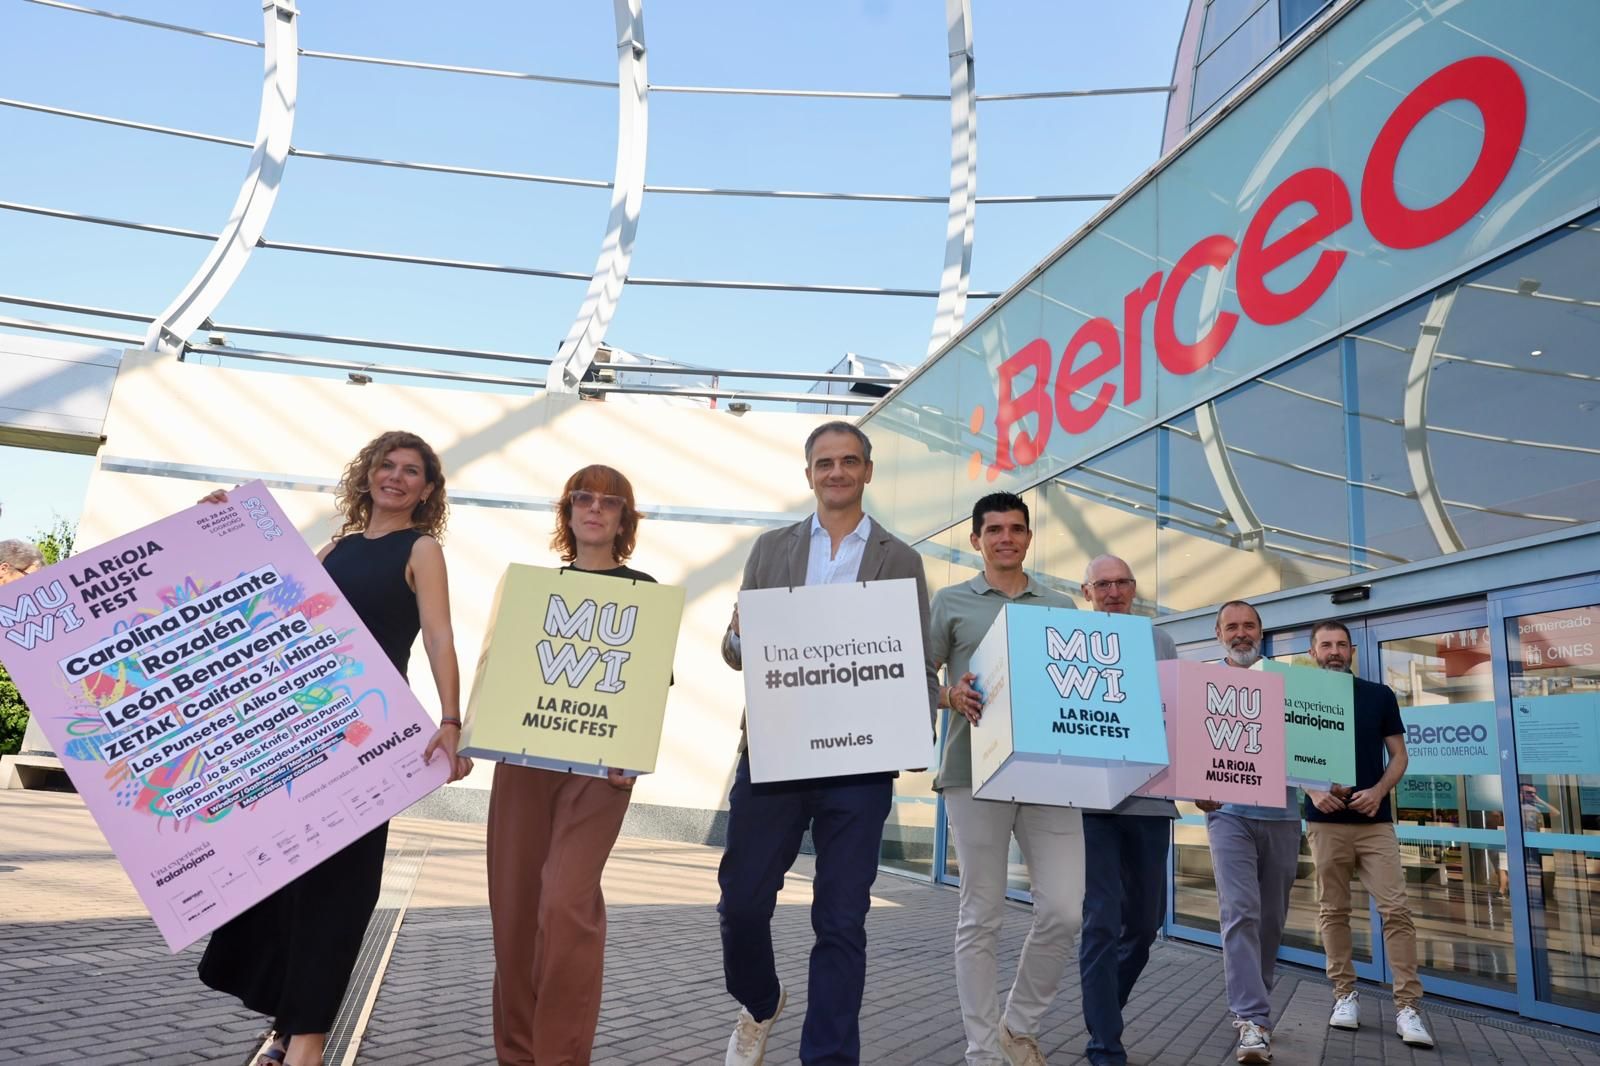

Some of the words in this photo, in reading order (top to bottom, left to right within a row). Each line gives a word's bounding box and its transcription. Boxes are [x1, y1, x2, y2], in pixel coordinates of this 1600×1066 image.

[986, 56, 1527, 482] Berceo
[196, 517, 210, 525] DEL
[212, 512, 238, 526] AGOSTO
[69, 566, 102, 588] LA
[89, 587, 139, 620] FEST
[66, 615, 181, 677] Carolina
[179, 570, 278, 624] Durante
[543, 593, 639, 646] MU
[141, 615, 247, 674] Rozalén
[763, 644, 799, 663] Una
[802, 636, 902, 662] experiencia
[1045, 626, 1121, 666] MU
[1547, 643, 1594, 660] CINES
[105, 682, 178, 729] León
[172, 617, 308, 692] Benavente
[536, 639, 632, 694] WI
[765, 660, 905, 689] #alariojana
[104, 714, 177, 760] ZETAK
[182, 670, 263, 719] Califato
[283, 633, 338, 667] Hinds
[1045, 662, 1128, 704] WI
[130, 750, 162, 774] Los
[162, 711, 236, 758] Punsetes
[242, 686, 279, 716] Aiko
[276, 680, 293, 696] el
[293, 659, 338, 690] grupo
[536, 696, 558, 712] LA
[1059, 707, 1076, 720] LA
[1206, 682, 1262, 720] MU
[1294, 698, 1345, 716] experiencia
[203, 742, 234, 761] Los
[232, 704, 300, 740] Bengala
[580, 721, 618, 738] FEST
[1100, 724, 1130, 740] FEST
[1204, 717, 1262, 754] WI
[1284, 710, 1345, 732] alariojana
[1406, 724, 1488, 745] Berceo
[357, 722, 422, 766] muwi.es
[810, 732, 874, 750] muwi.es
[1408, 746, 1440, 758] CENTRO
[1440, 746, 1488, 757] COMERCIAL
[166, 780, 202, 804] Paipo
[206, 770, 220, 783] Jo
[220, 764, 230, 775] &
[230, 746, 262, 769] Swiss
[260, 731, 290, 751] Knife
[292, 716, 320, 734] Pata
[175, 802, 195, 819] Pin
[194, 788, 217, 808] Pan
[217, 775, 245, 798] Pum
[249, 744, 301, 776] Amadeus
[300, 725, 334, 749] MUWI
[332, 708, 360, 730] Band
[282, 773, 297, 787] por
[293, 756, 326, 778] confirmar
[1212, 758, 1226, 770] LA
[1294, 754, 1328, 766] muwi.es
[1240, 773, 1262, 786] FEST
[156, 848, 216, 888] #alariojana
